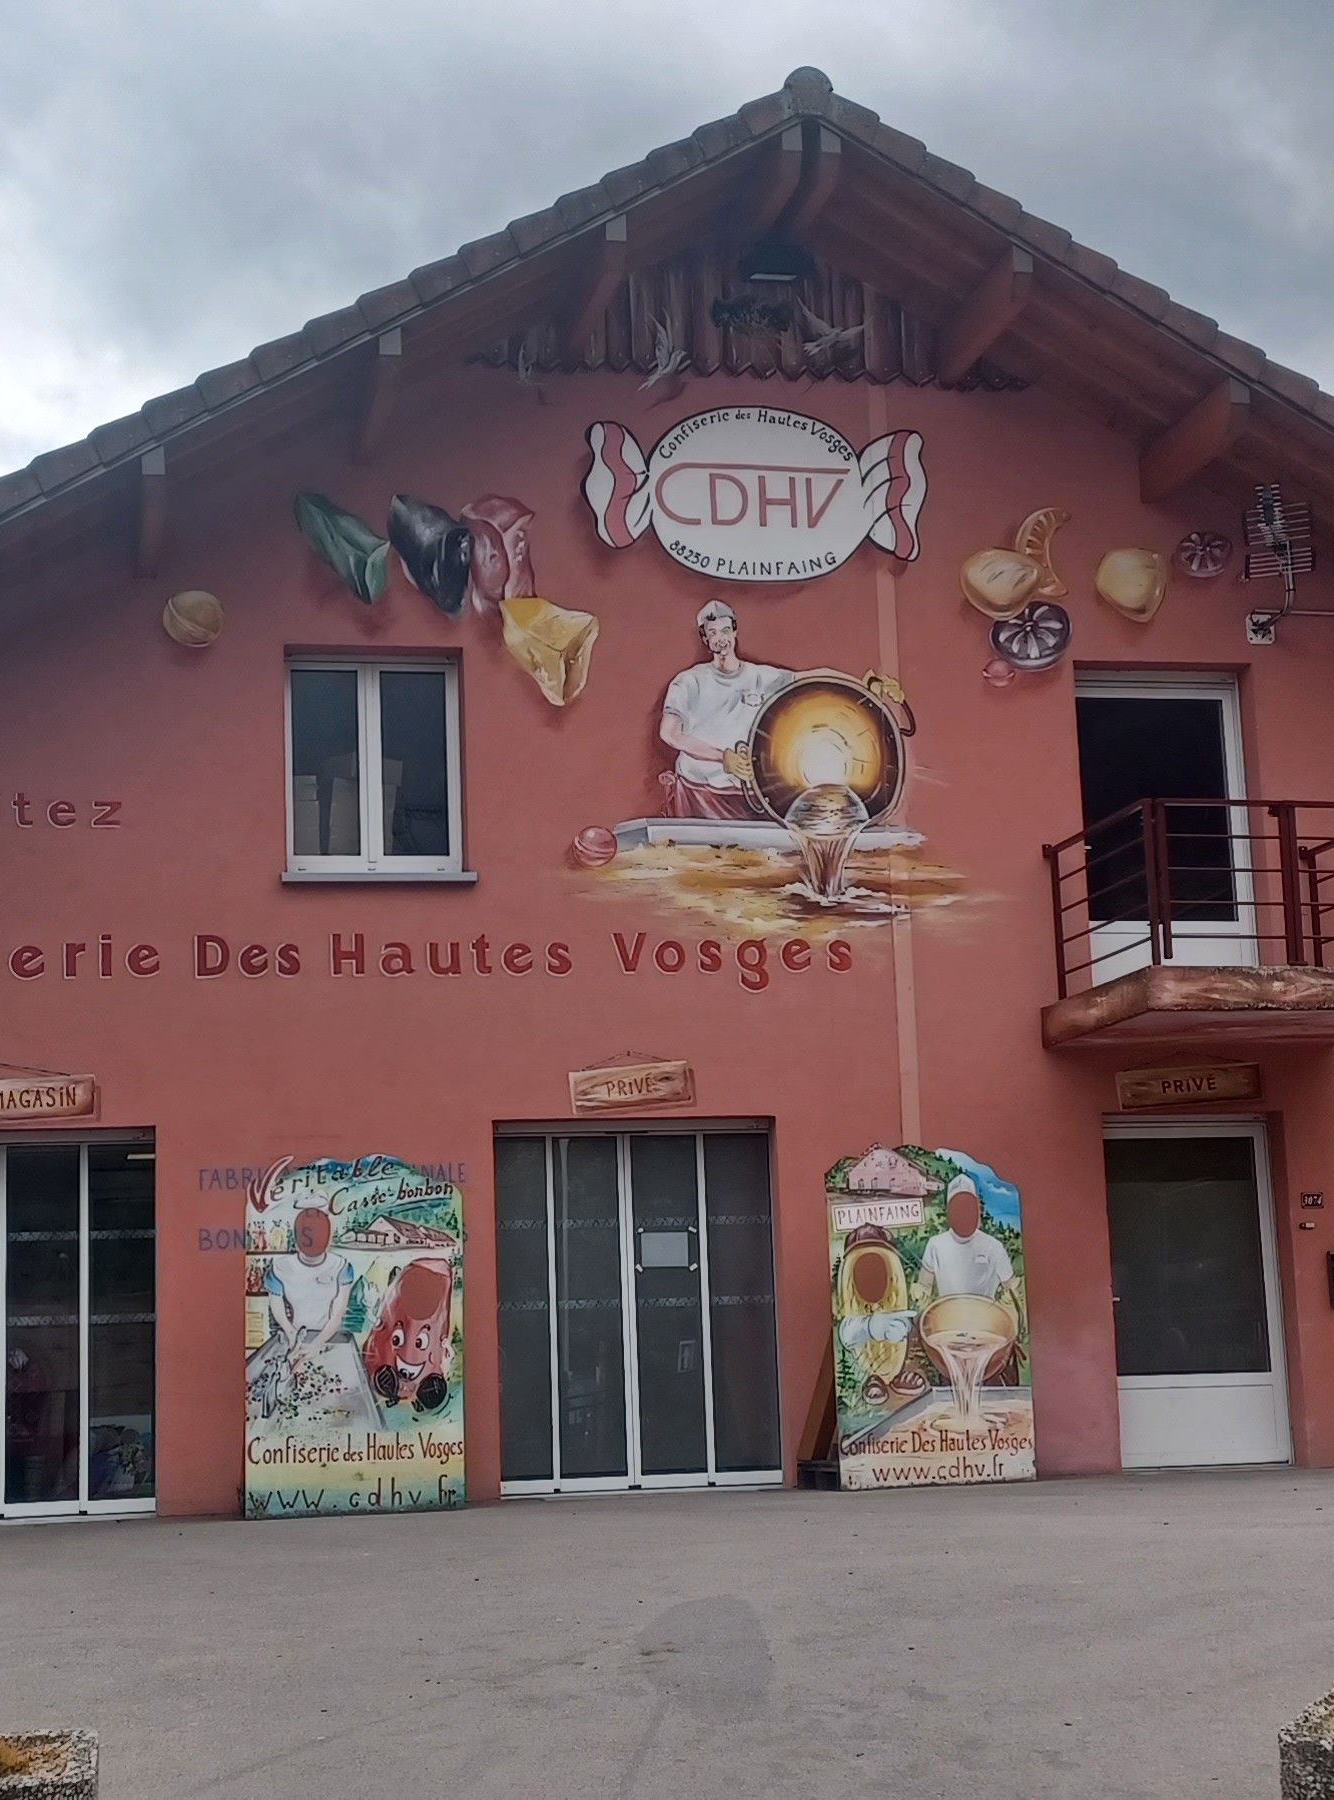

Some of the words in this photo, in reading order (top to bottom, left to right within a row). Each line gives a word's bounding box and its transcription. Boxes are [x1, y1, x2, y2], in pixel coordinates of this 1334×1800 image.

[659, 410, 730, 459] Confiserie
[735, 409, 751, 421] des
[757, 409, 810, 431] Hautes
[810, 424, 855, 462] Vosges
[655, 462, 851, 529] CDHV
[715, 551, 838, 576] PLAINFAING
[193, 933, 302, 979] Des
[328, 932, 573, 978] Hautes
[612, 931, 854, 993] Vosges
[247, 1155, 400, 1213] Véritable
[837, 1203, 920, 1225] PLAINFAING
[247, 1435, 340, 1465] Confiserie
[343, 1433, 364, 1463] des
[366, 1432, 415, 1461] Hautes
[418, 1432, 464, 1465] Vosges
[840, 1433, 908, 1457] Confiserie
[911, 1430, 936, 1453] Des
[939, 1429, 987, 1452] Hautes
[988, 1428, 1034, 1456] Vosges
